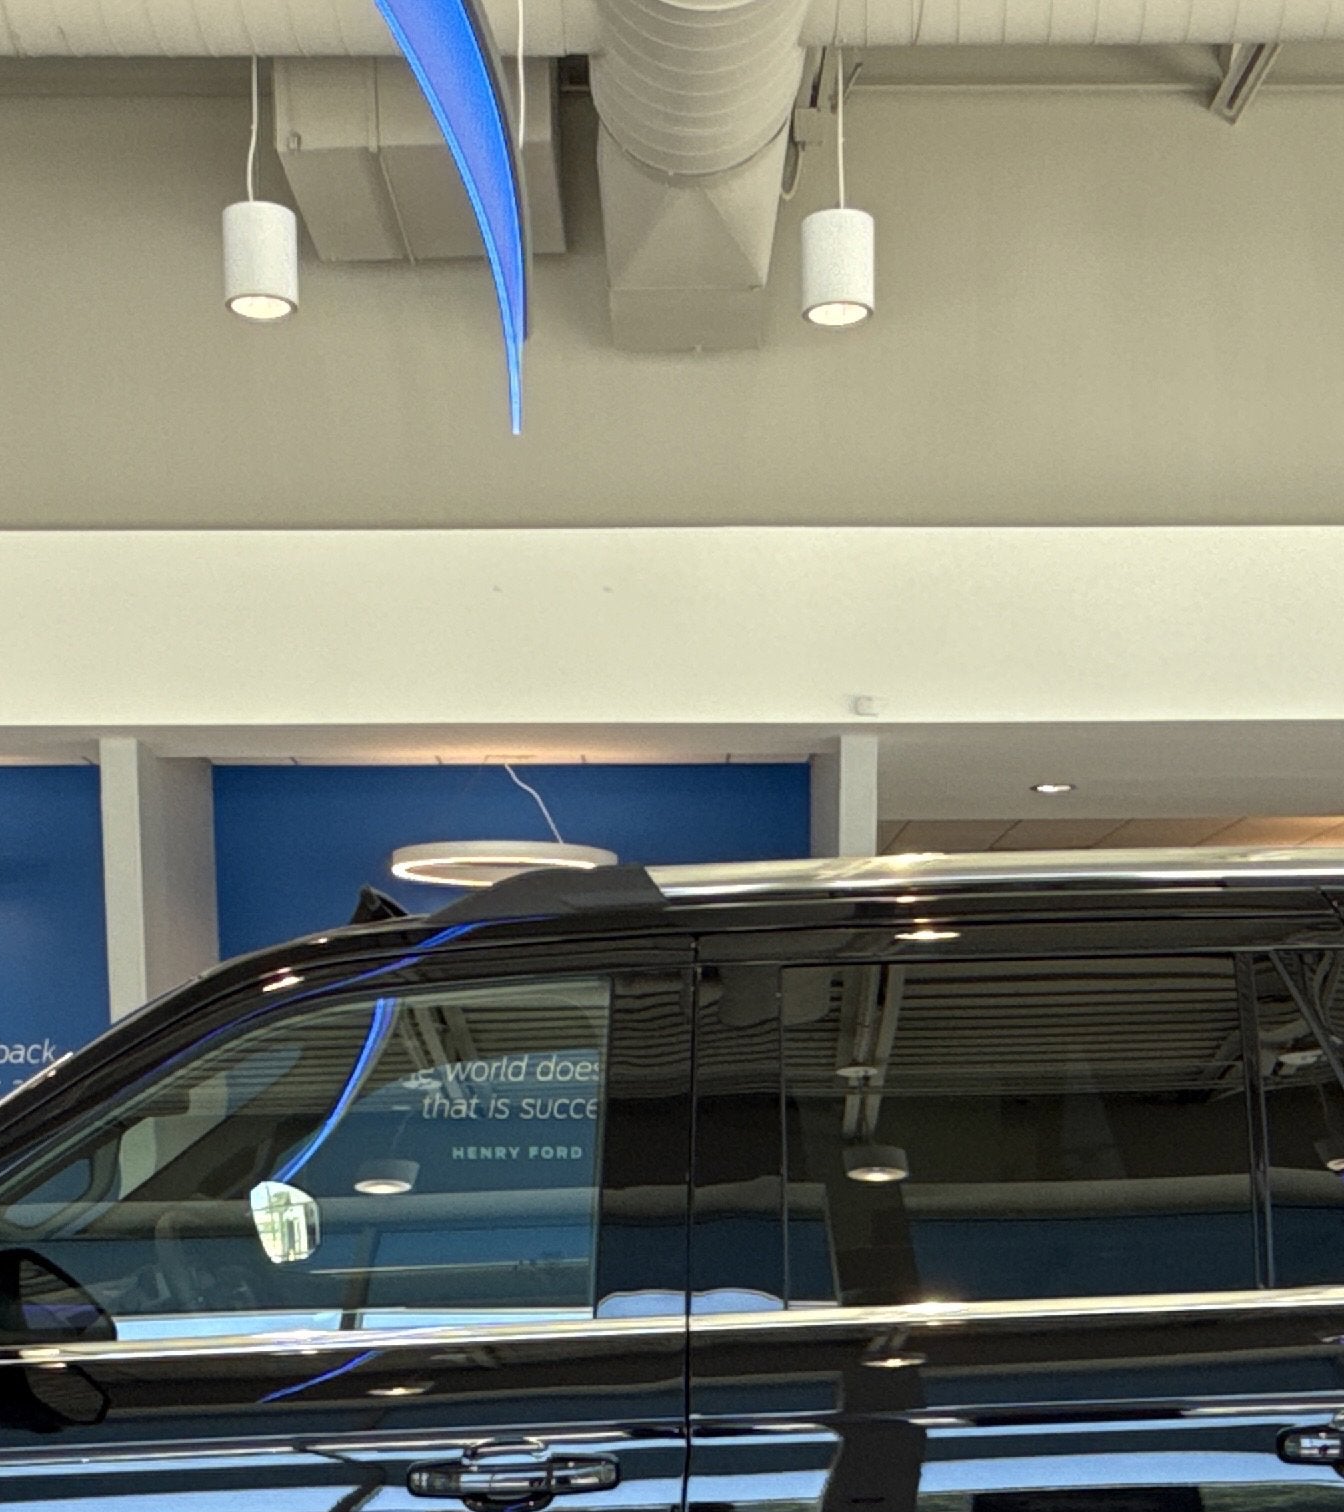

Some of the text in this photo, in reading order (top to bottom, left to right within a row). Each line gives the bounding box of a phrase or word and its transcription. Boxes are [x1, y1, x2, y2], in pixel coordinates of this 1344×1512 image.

[445, 1054, 529, 1083] world
[422, 1092, 480, 1120] that
[488, 1093, 511, 1120] is
[452, 1146, 583, 1160] HENRY FORD
